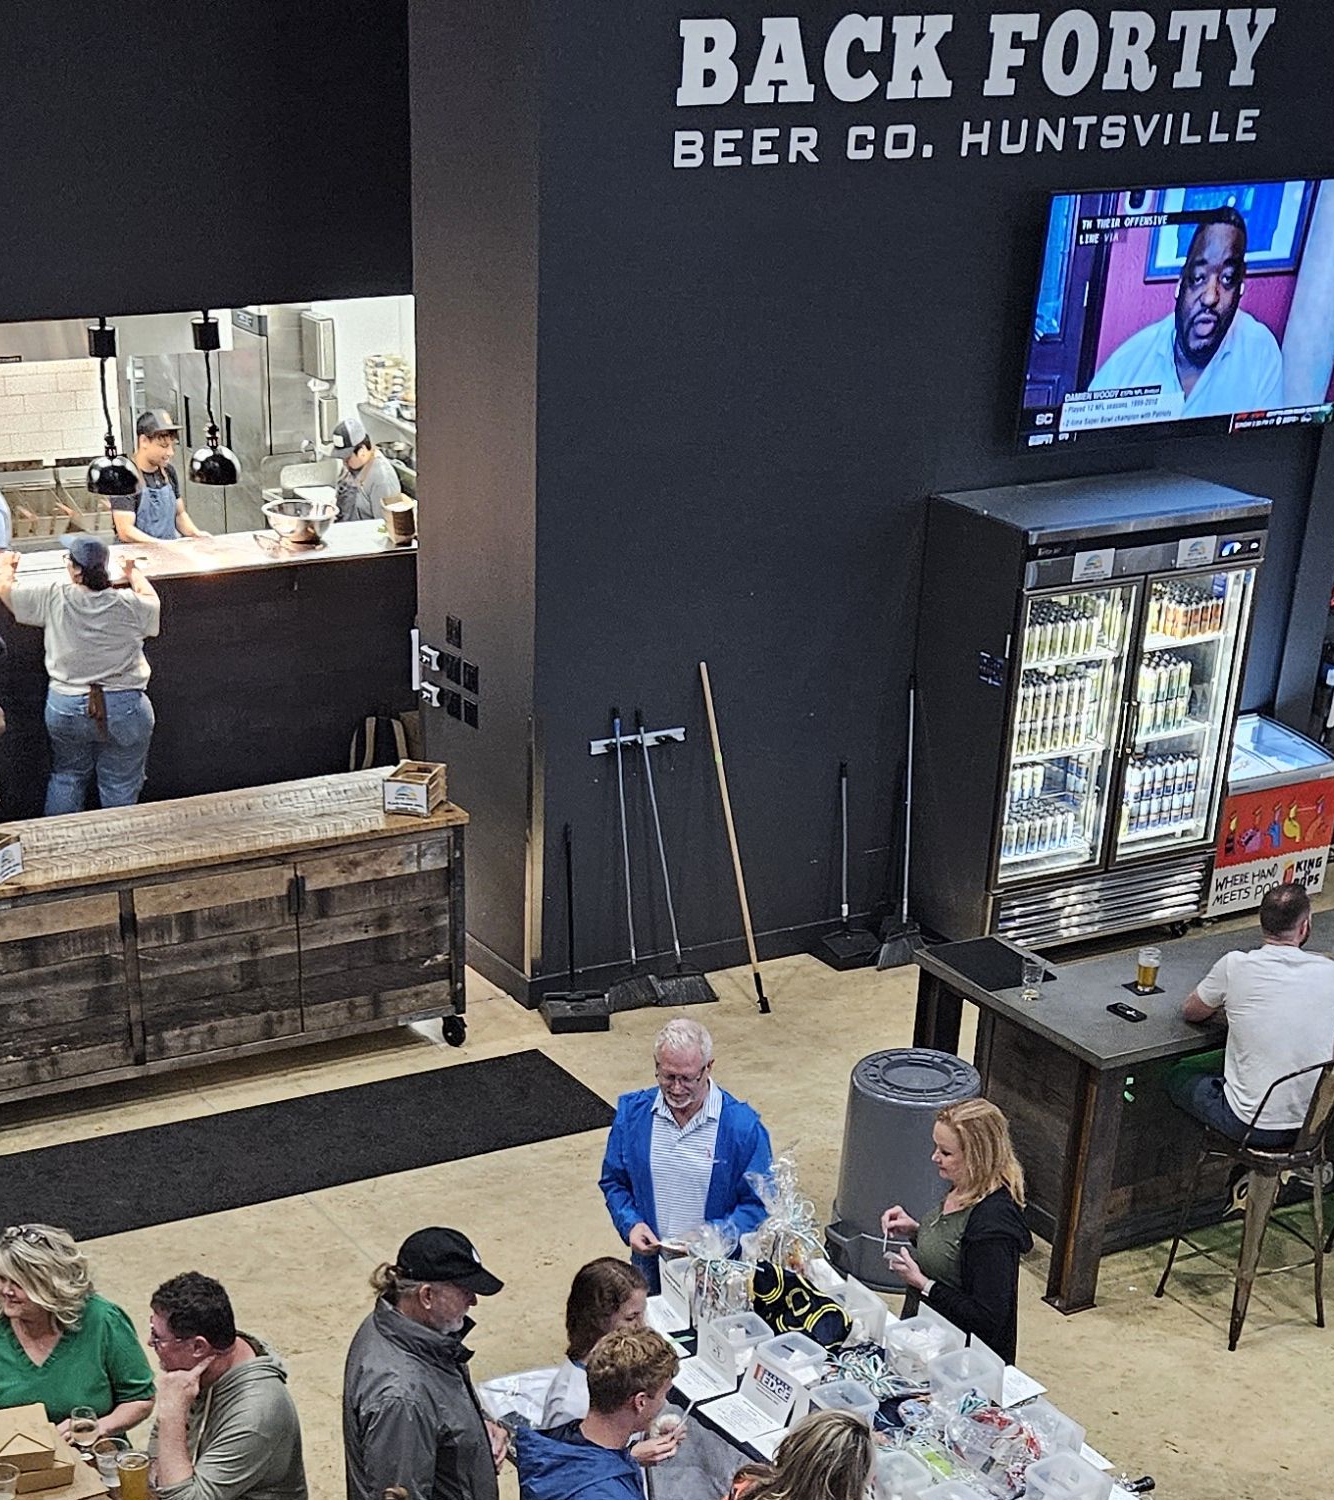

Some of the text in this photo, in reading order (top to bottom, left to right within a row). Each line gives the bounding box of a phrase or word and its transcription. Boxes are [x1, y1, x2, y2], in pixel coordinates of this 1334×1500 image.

[676, 7, 1277, 107] BACK FORTY
[673, 109, 1261, 168] BEER CO. HUNTSVILLE
[1096, 217, 1121, 229] THEIR
[1124, 214, 1169, 228] OFFENSIVE
[1079, 231, 1120, 246] LINE VIA
[1093, 389, 1119, 400] WOODY
[1067, 405, 1086, 414] Played
[1087, 404, 1094, 412] 12
[1095, 403, 1105, 411] NFL
[1035, 412, 1054, 425] SC
[1084, 417, 1099, 427] Super
[1100, 415, 1113, 424] Bowl
[1114, 413, 1141, 423] champion
[1295, 855, 1323, 873] KING
[1215, 863, 1278, 892] WHERE HAND
[1212, 886, 1251, 906] MEETS
[761, 1373, 792, 1401] EDGE
